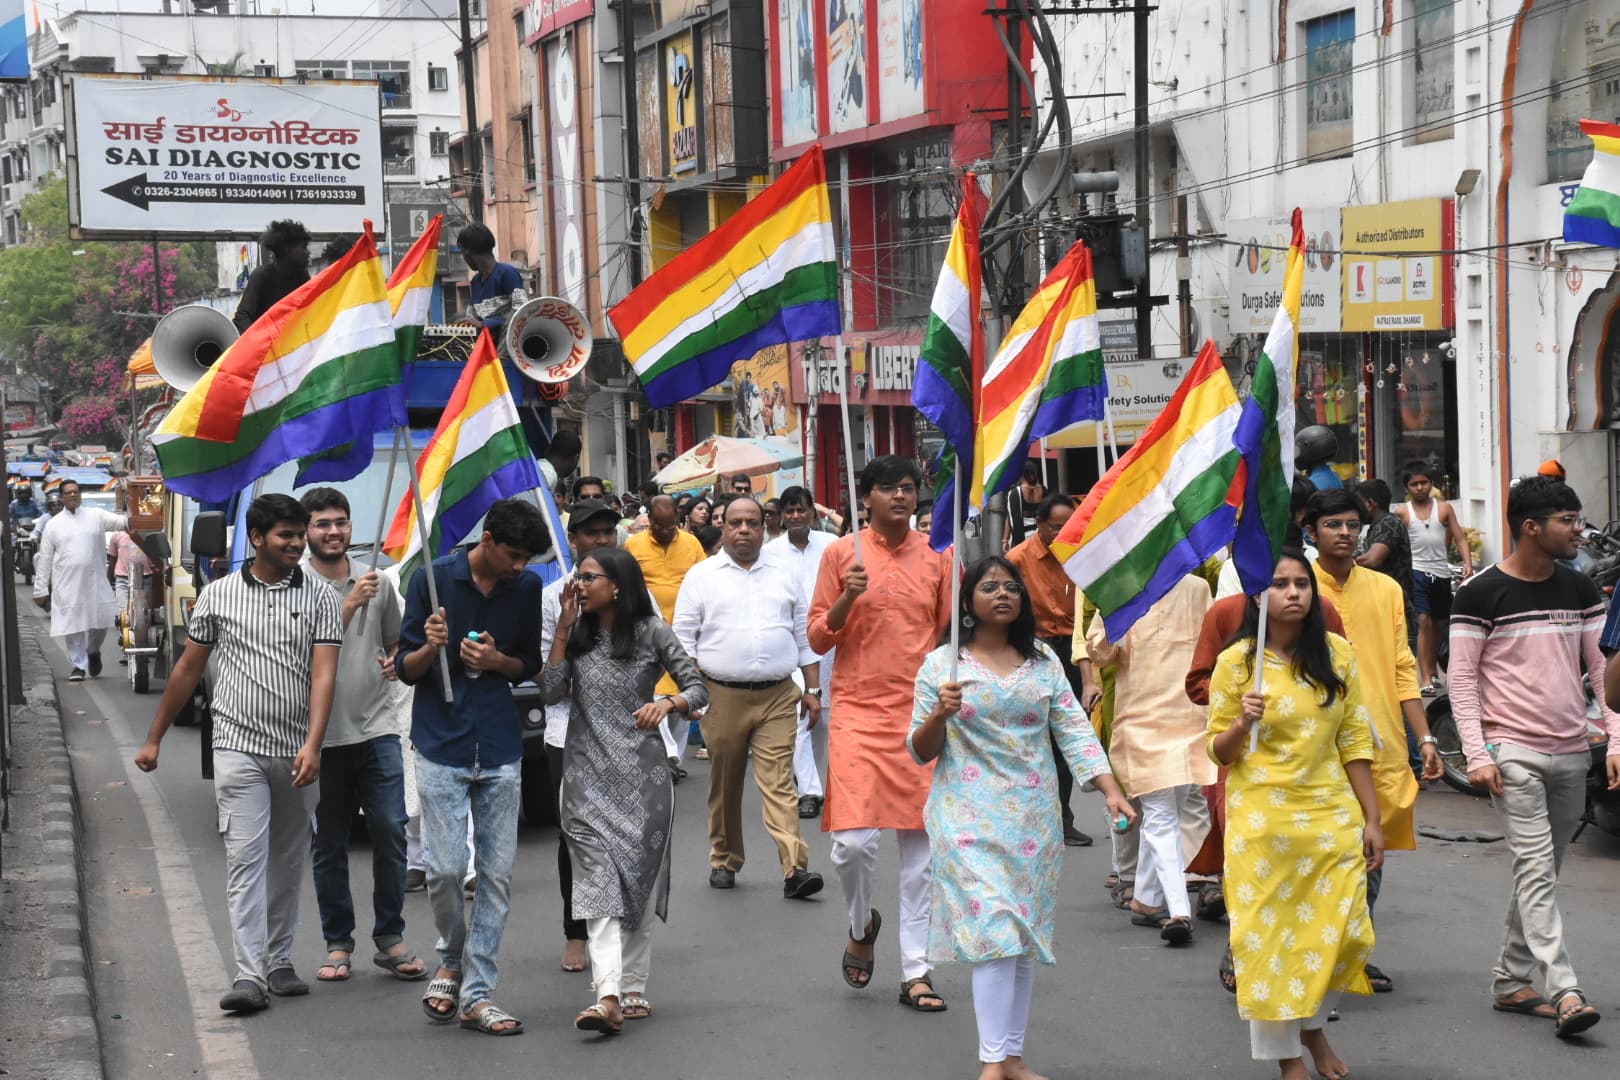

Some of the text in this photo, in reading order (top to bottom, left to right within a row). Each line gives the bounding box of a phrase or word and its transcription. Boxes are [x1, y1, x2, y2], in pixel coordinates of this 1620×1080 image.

[102, 116, 360, 145] साई डायग्नोस्टिक
[105, 147, 360, 170] SAI DIAGNOSTIC
[164, 170, 346, 184] 20 Years of Diagnostic Excellence
[225, 188, 287, 199] 9334014901
[296, 189, 357, 199] 7361933339
[1356, 227, 1424, 244] Authorized Distributors
[1242, 289, 1325, 313] Durga Safet utions
[872, 345, 921, 390] LIBERT
[1108, 394, 1172, 407] fety Solutio
